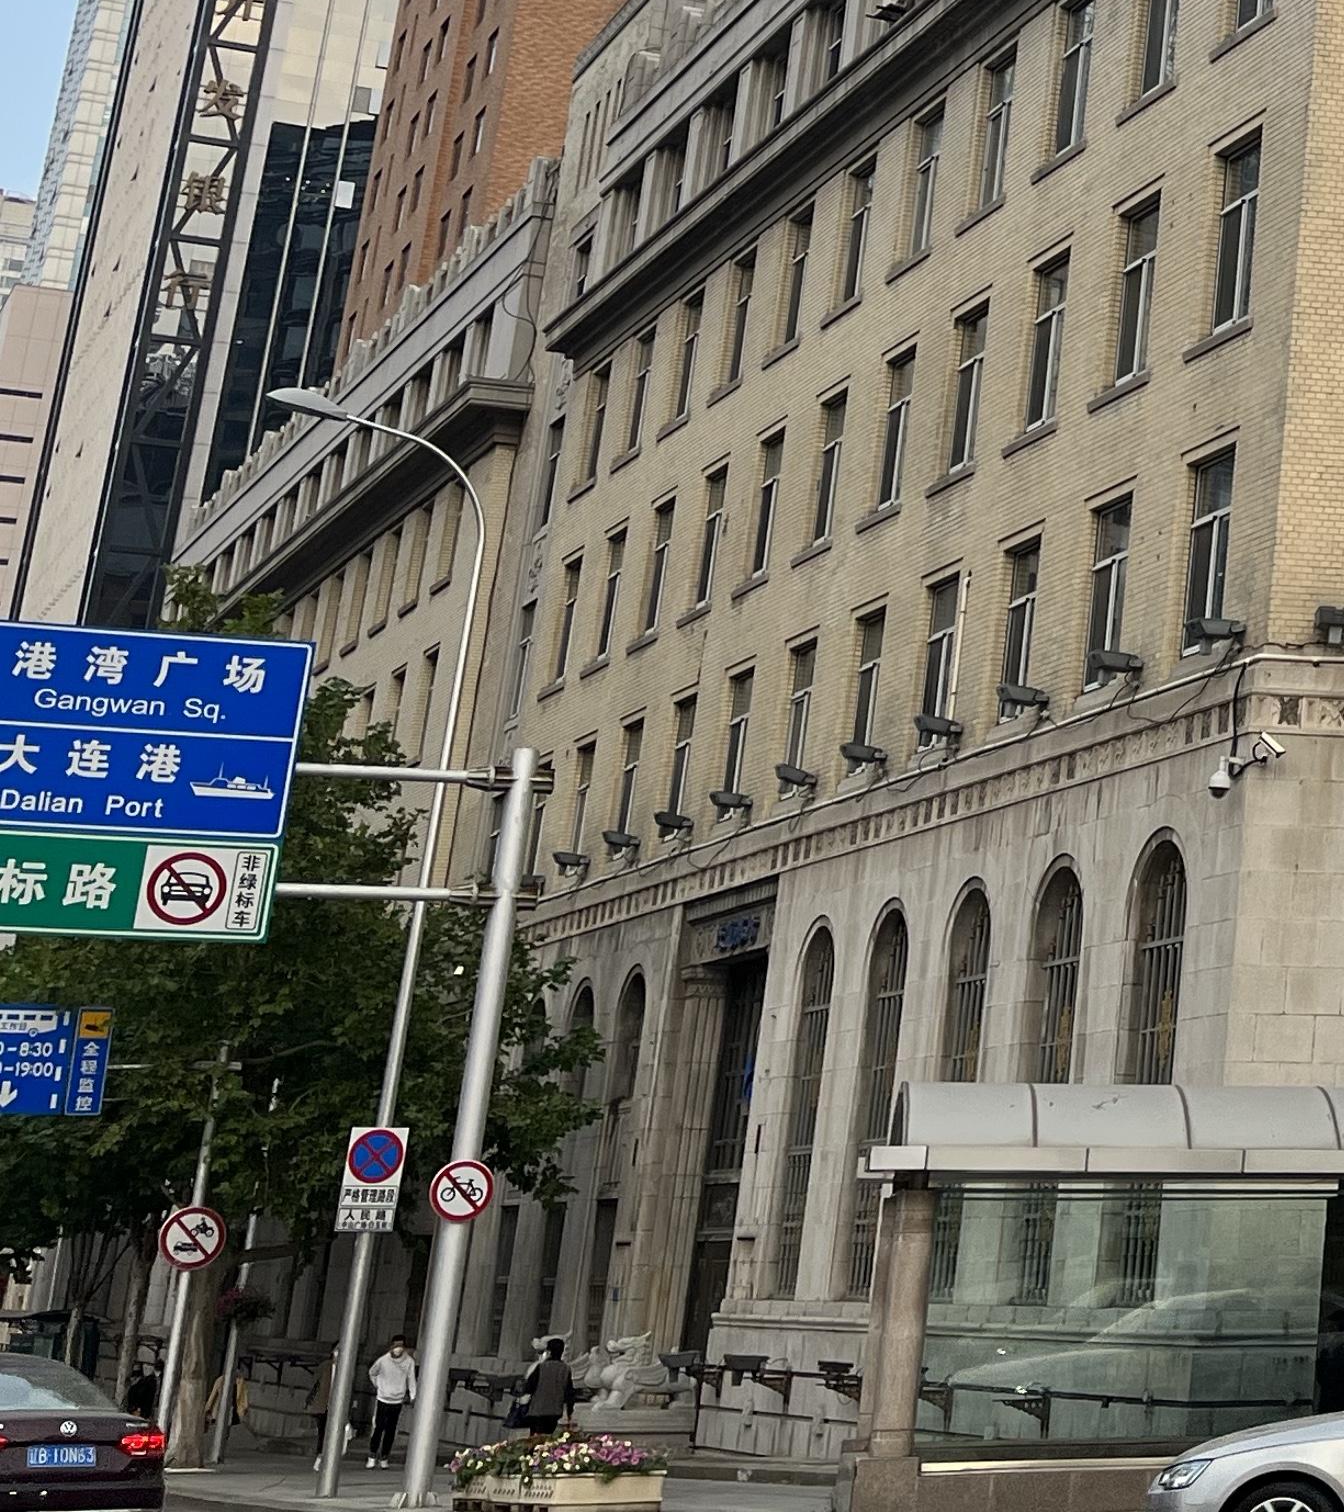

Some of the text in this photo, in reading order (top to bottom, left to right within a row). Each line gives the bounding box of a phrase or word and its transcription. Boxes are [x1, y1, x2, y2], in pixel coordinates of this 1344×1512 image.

[12, 640, 266, 694] 港湾广场
[33, 688, 226, 723] Gangwan Sq.
[0, 734, 181, 784] 大连港
[0, 789, 164, 819] Dalian Port
[0, 858, 117, 910] 标路
[231, 854, 261, 928] 非绿标车
[0, 1061, 54, 1078] -19:00
